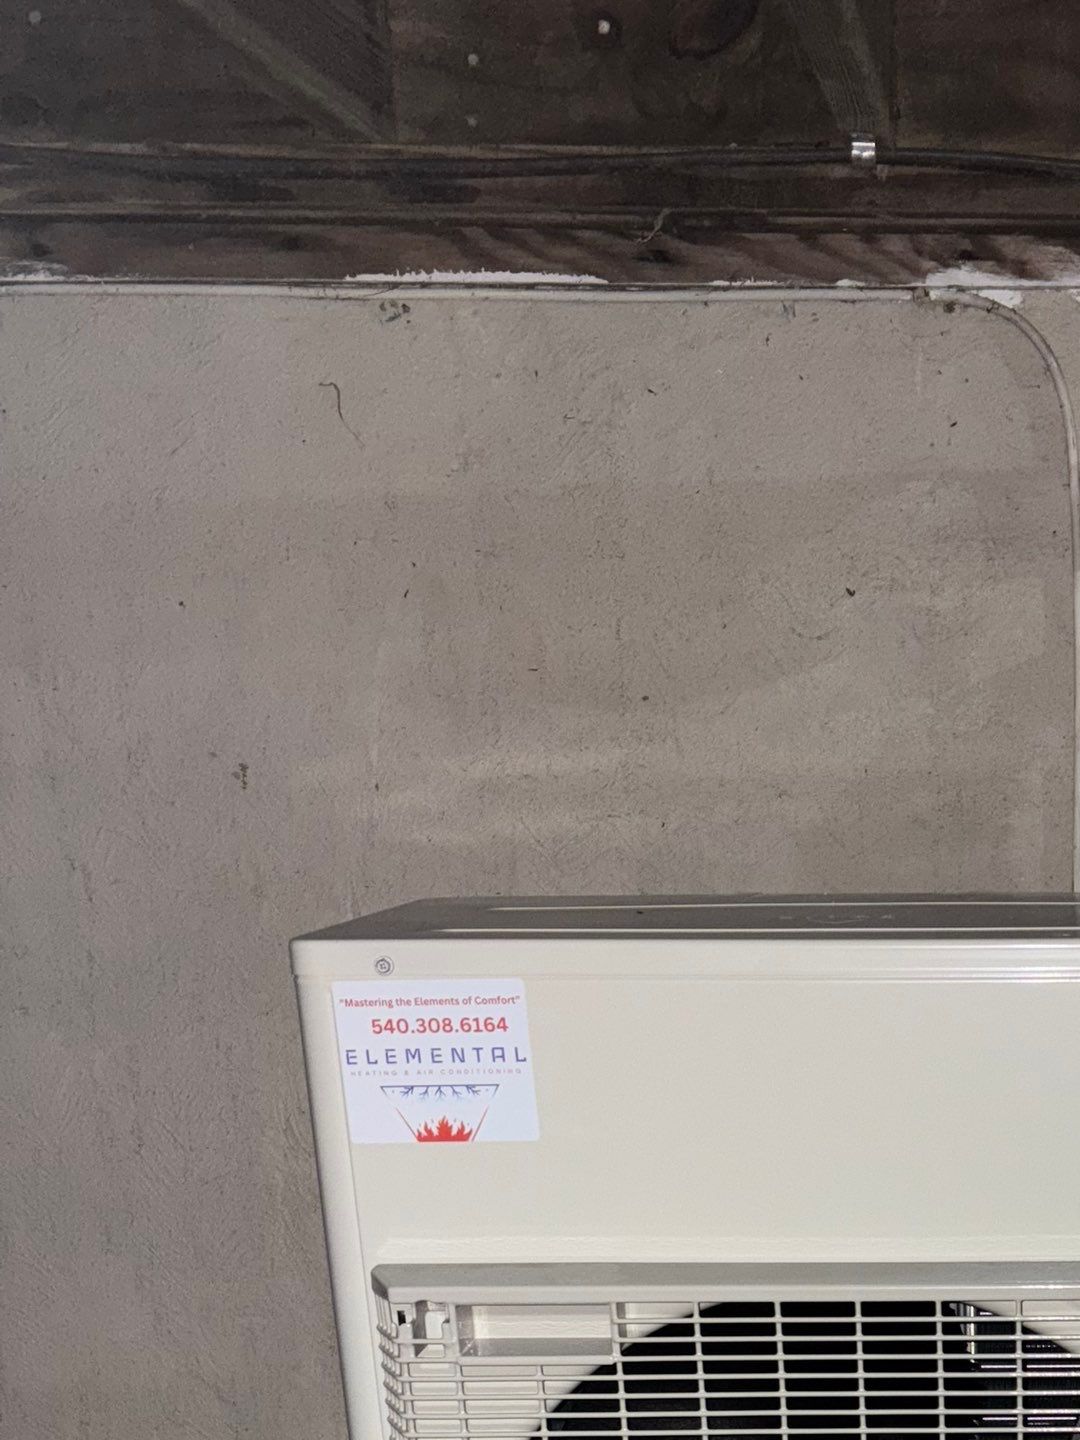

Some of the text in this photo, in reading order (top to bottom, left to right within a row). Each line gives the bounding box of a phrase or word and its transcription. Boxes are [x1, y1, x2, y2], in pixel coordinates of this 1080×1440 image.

[339, 994, 520, 1008] "Mastering the Elements of Comfort"
[371, 1017, 509, 1035] 540.308.6164
[345, 1046, 527, 1065] ELEMENTAL
[350, 1069, 398, 1077] HEATING
